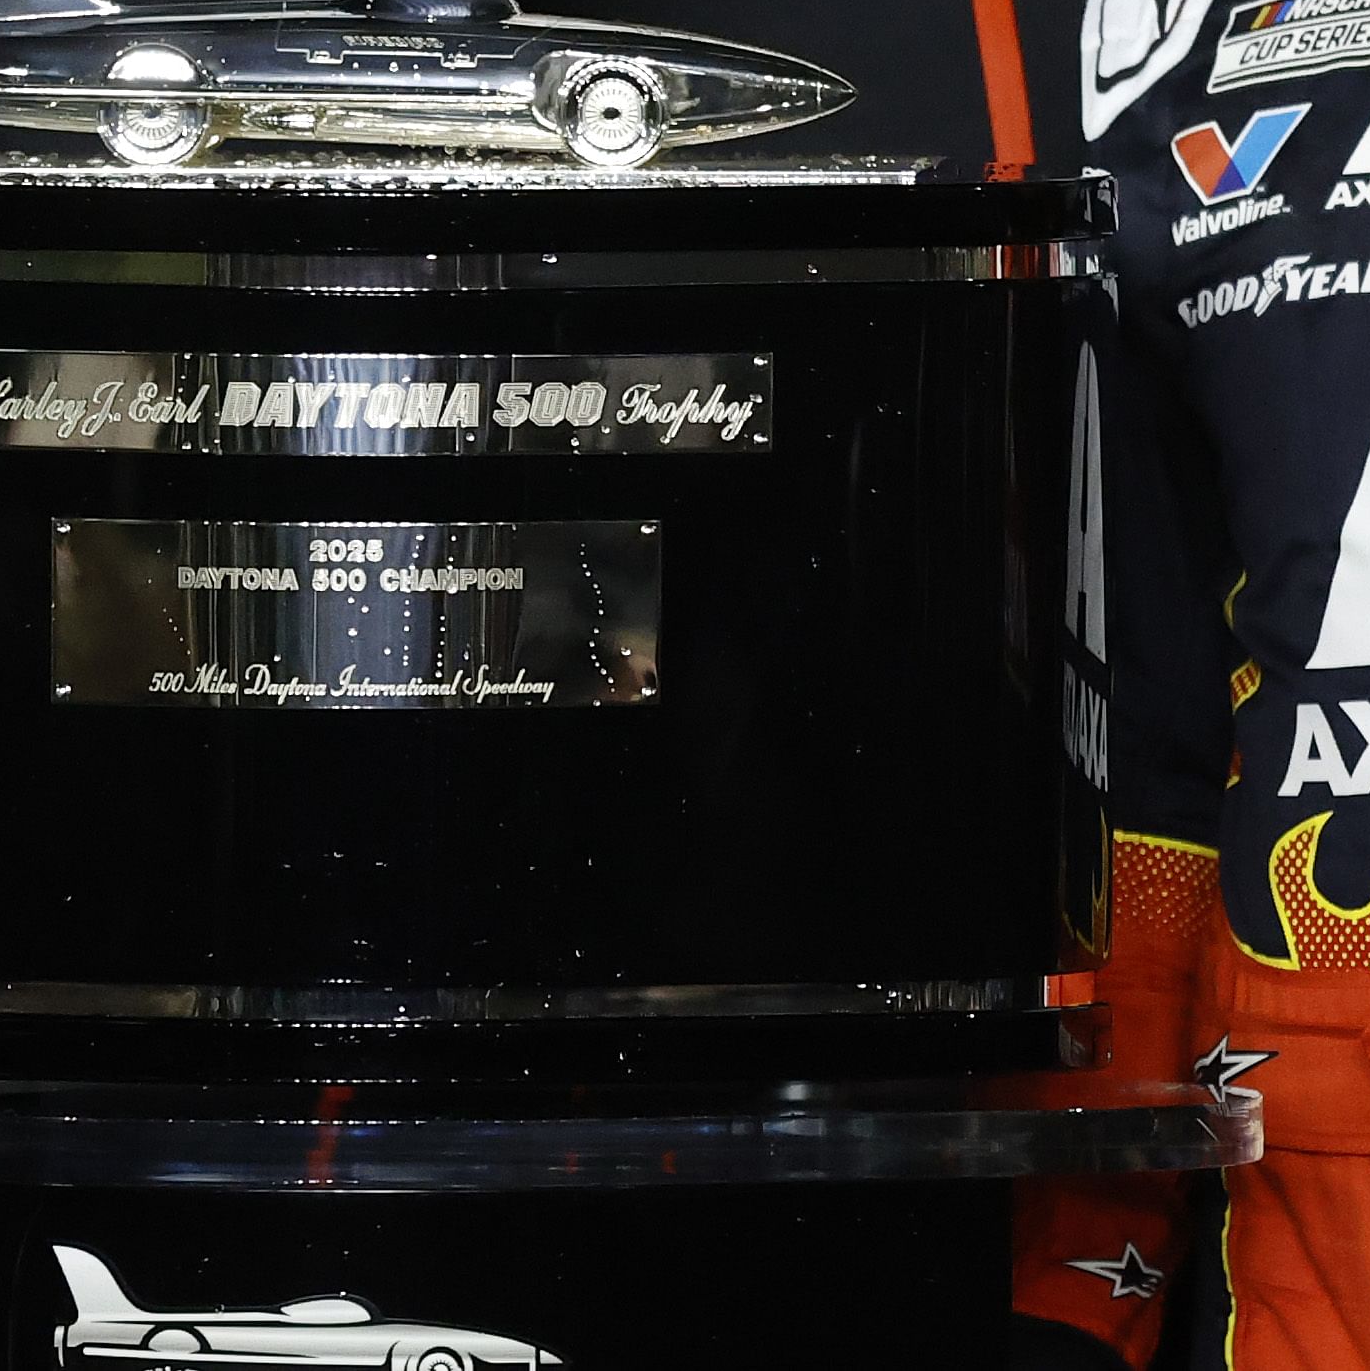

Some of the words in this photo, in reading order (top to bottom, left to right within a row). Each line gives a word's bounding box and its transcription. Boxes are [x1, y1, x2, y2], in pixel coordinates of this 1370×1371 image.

[1240, 34, 1293, 65] CUP
[1171, 194, 1285, 246] Valvoline
[129, 382, 211, 423] Earl
[220, 382, 480, 428] DAYTONA
[493, 382, 607, 427] 500
[616, 383, 753, 441] Trophy
[309, 539, 384, 562] 2025
[177, 567, 299, 591] DAYTONA
[311, 567, 367, 592] 500
[379, 567, 524, 593] CHAMPION
[149, 671, 183, 693] 500
[244, 664, 327, 704] Daytona
[329, 664, 463, 698] International
[461, 664, 556, 704] Speedway
